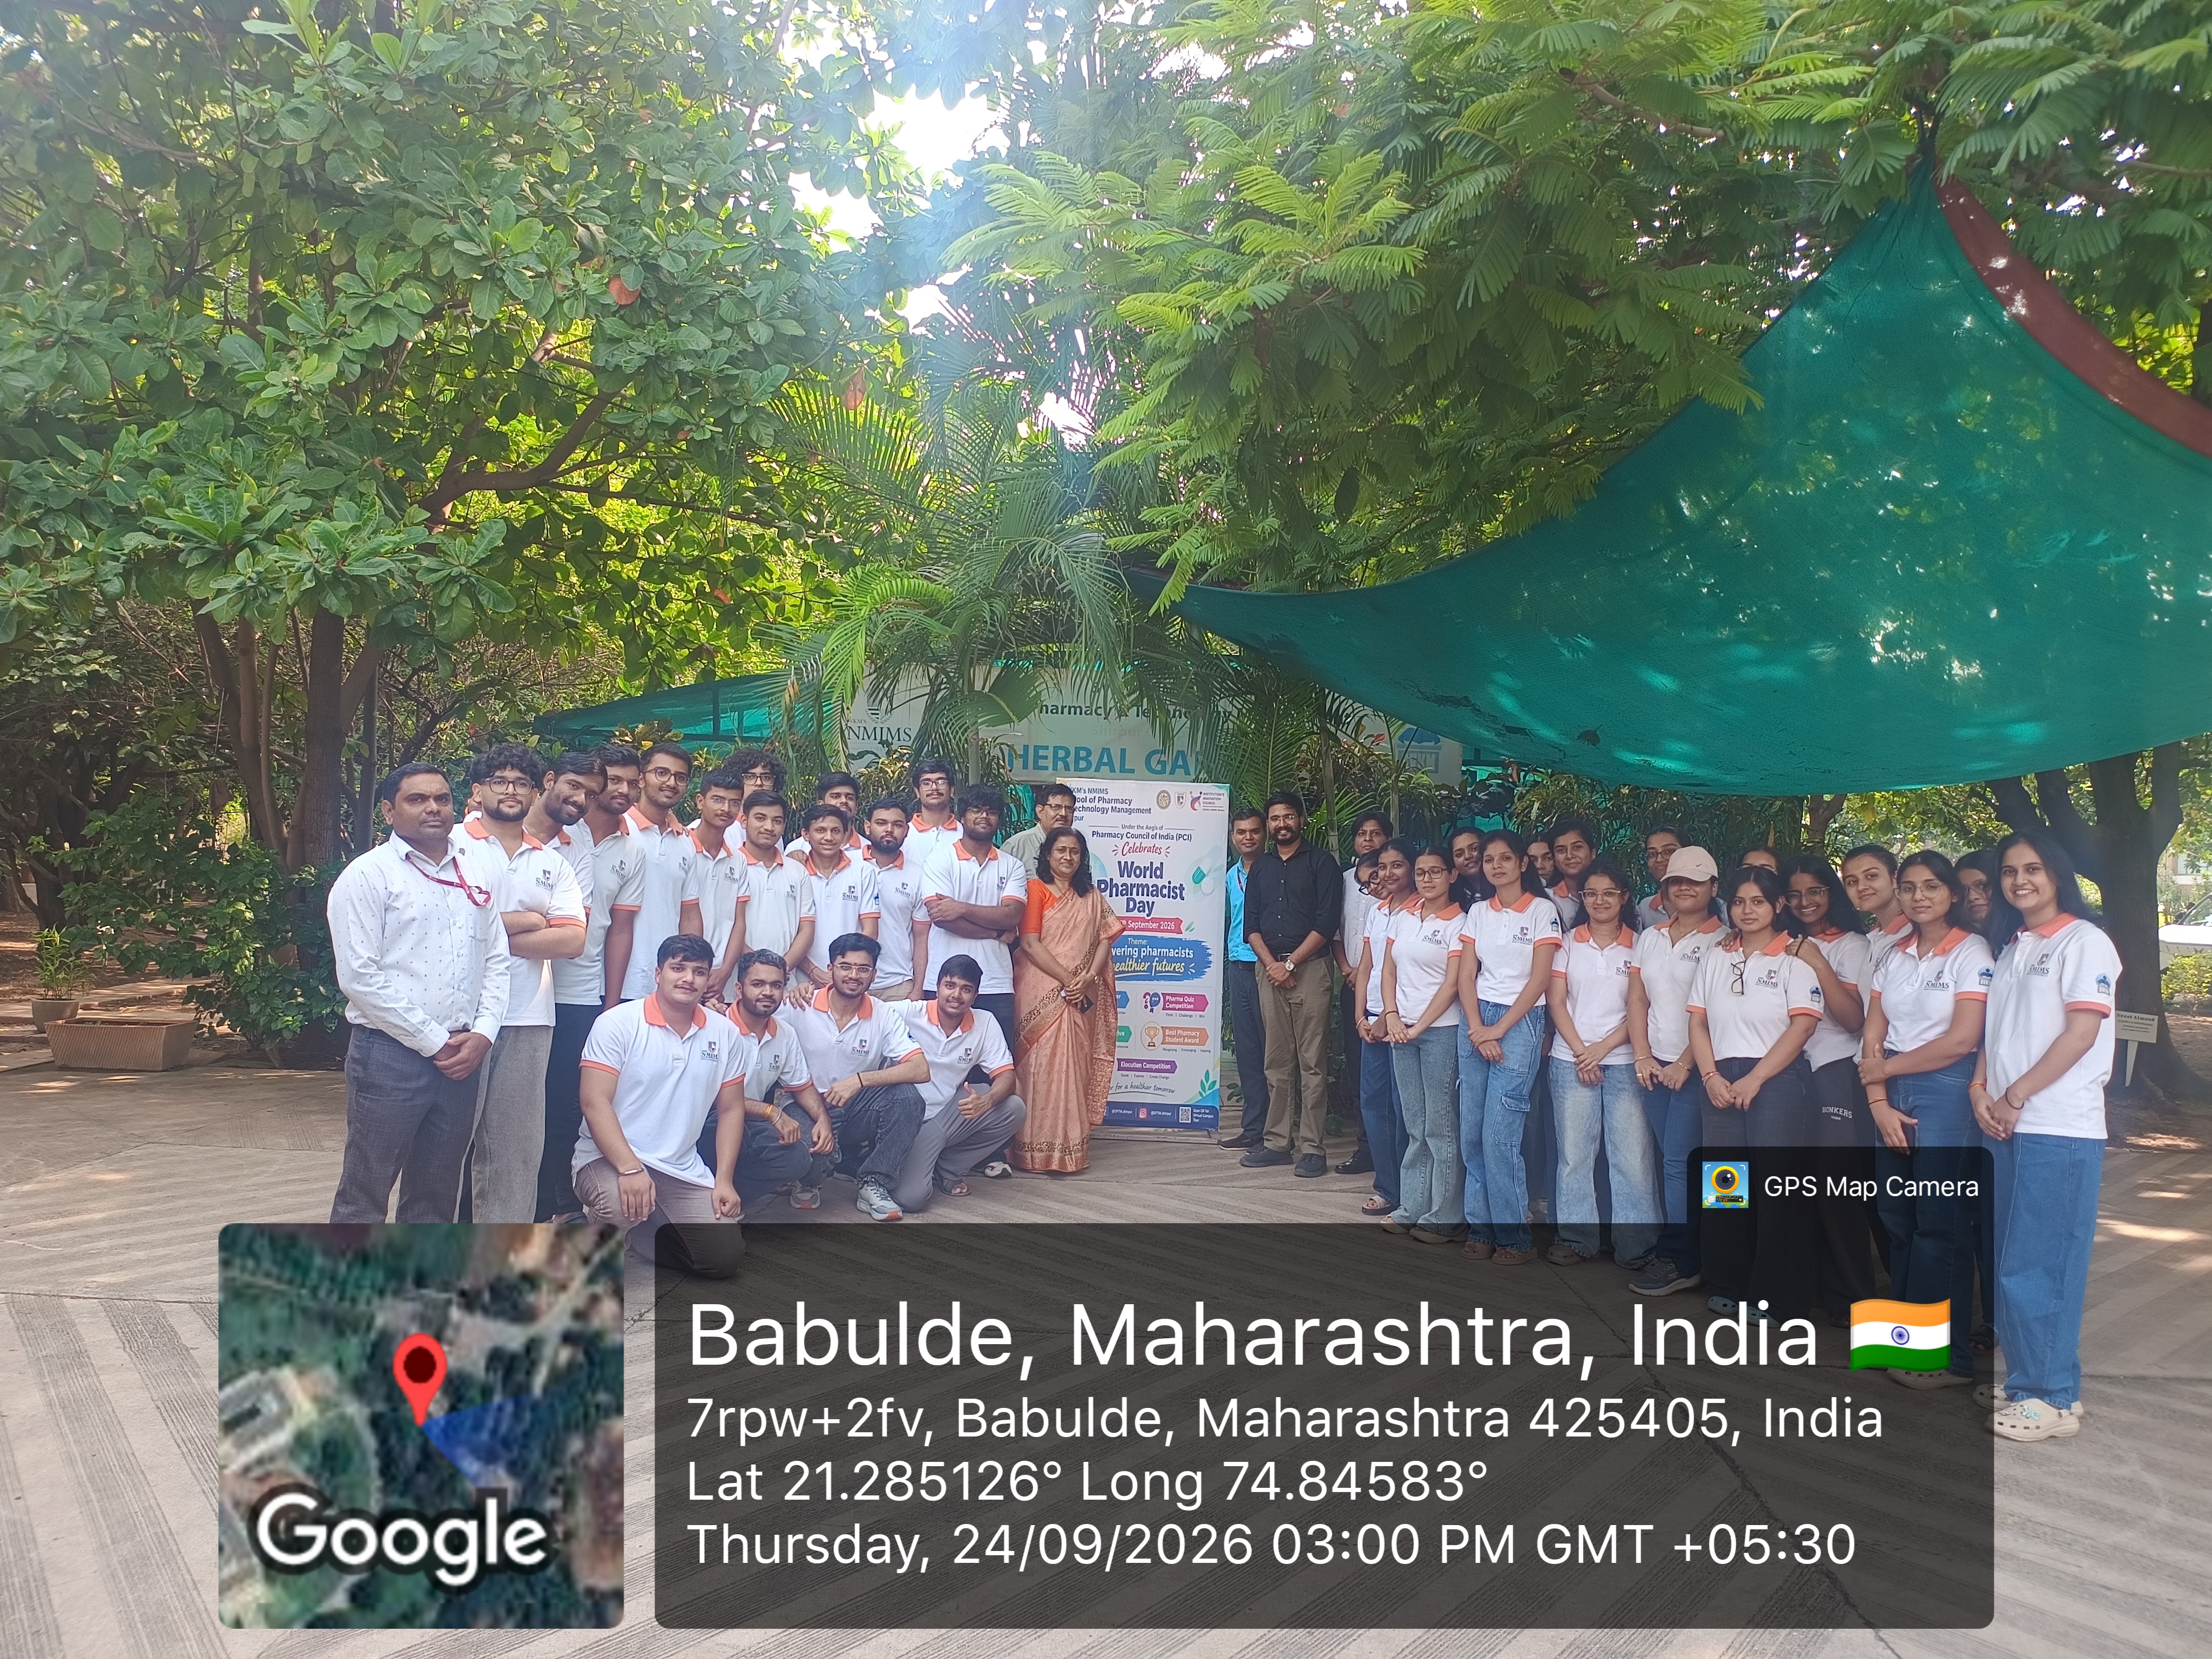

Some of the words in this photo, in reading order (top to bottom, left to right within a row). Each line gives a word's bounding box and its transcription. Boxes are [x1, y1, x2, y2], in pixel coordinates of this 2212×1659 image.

[1040, 704, 1115, 720] harmacy
[847, 726, 912, 741] NMIMS
[1008, 744, 1135, 774] HERBAL
[1098, 797, 1132, 806] Pharmacy
[1074, 805, 1109, 814] echnology
[1111, 806, 1152, 815] Management
[1092, 831, 1124, 840] Pharmacy
[1125, 832, 1150, 840] Council
[1176, 833, 1192, 842] (PCI)
[1121, 841, 1163, 857] Celebrates
[1117, 860, 1164, 879] World
[1097, 878, 1185, 901] Pharmacist
[1125, 897, 1156, 917] Day
[1128, 920, 1159, 930] September
[1160, 921, 1175, 929] 2026
[1141, 945, 1194, 959] pharmacists
[1113, 957, 1151, 972] ealthier
[1151, 957, 1185, 976] futures
[2027, 966, 2050, 974] NMIMS
[1756, 978, 1778, 987] NMIMS
[702, 1051, 718, 1060] NMIM
[1143, 1062, 1171, 1070] Competition
[1115, 1082, 1123, 1091] for
[1130, 1081, 1152, 1090] healthier
[1153, 1084, 1176, 1094] tomorrow
[1822, 1107, 1853, 1118] BONKERS
